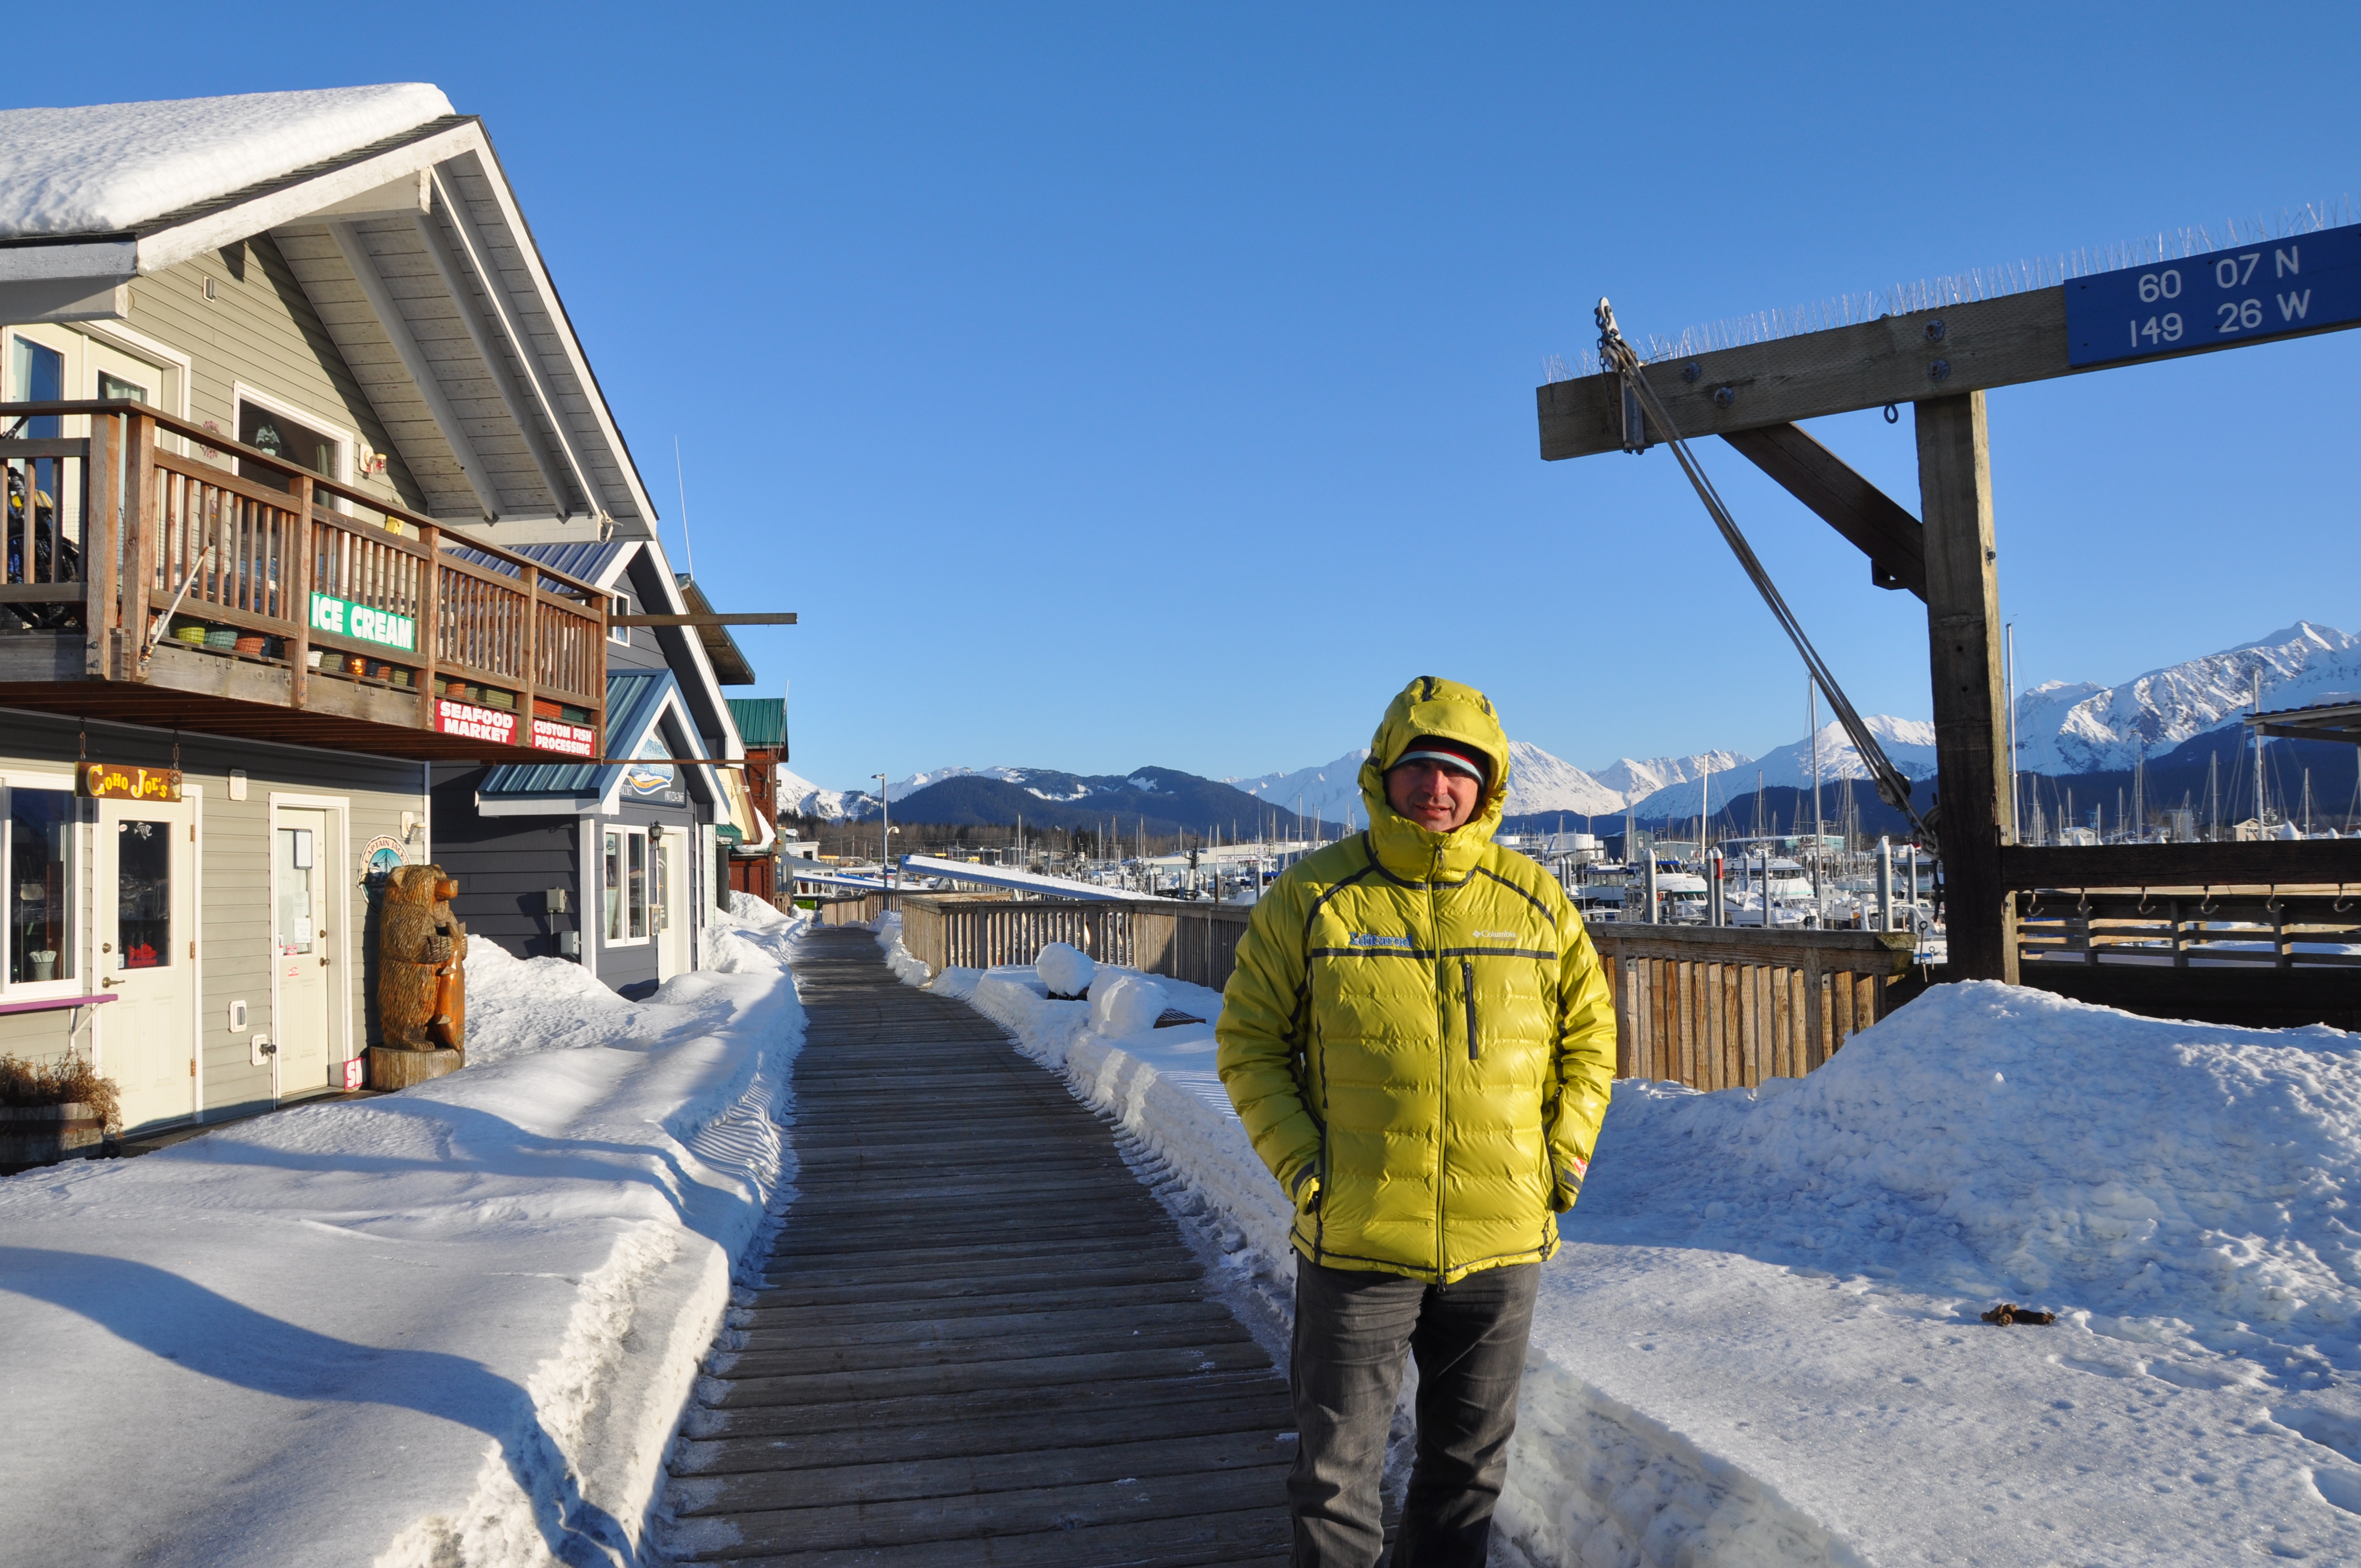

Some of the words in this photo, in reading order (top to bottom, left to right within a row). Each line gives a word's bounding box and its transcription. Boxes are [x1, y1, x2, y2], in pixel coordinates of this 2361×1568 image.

[2139, 269, 2182, 303] 60
[2216, 253, 2261, 288] 07
[2275, 246, 2299, 278] N
[2130, 312, 2183, 348] 149
[2217, 298, 2262, 333] 26
[2276, 289, 2310, 321] W
[312, 595, 344, 633] ICE
[350, 606, 412, 650] CREAM
[440, 701, 513, 729] SEAFOOD
[444, 718, 509, 743] MARKET
[534, 720, 570, 738] CUSTOM
[573, 728, 592, 743] FISH
[535, 734, 591, 756] PROCESSING
[86, 764, 129, 797] COHO
[649, 765, 673, 777] OUTFITTERS
[365, 840, 390, 864] CAPTAIN
[1350, 932, 1413, 948] Iditarod
[1481, 929, 1516, 938] Columbia
